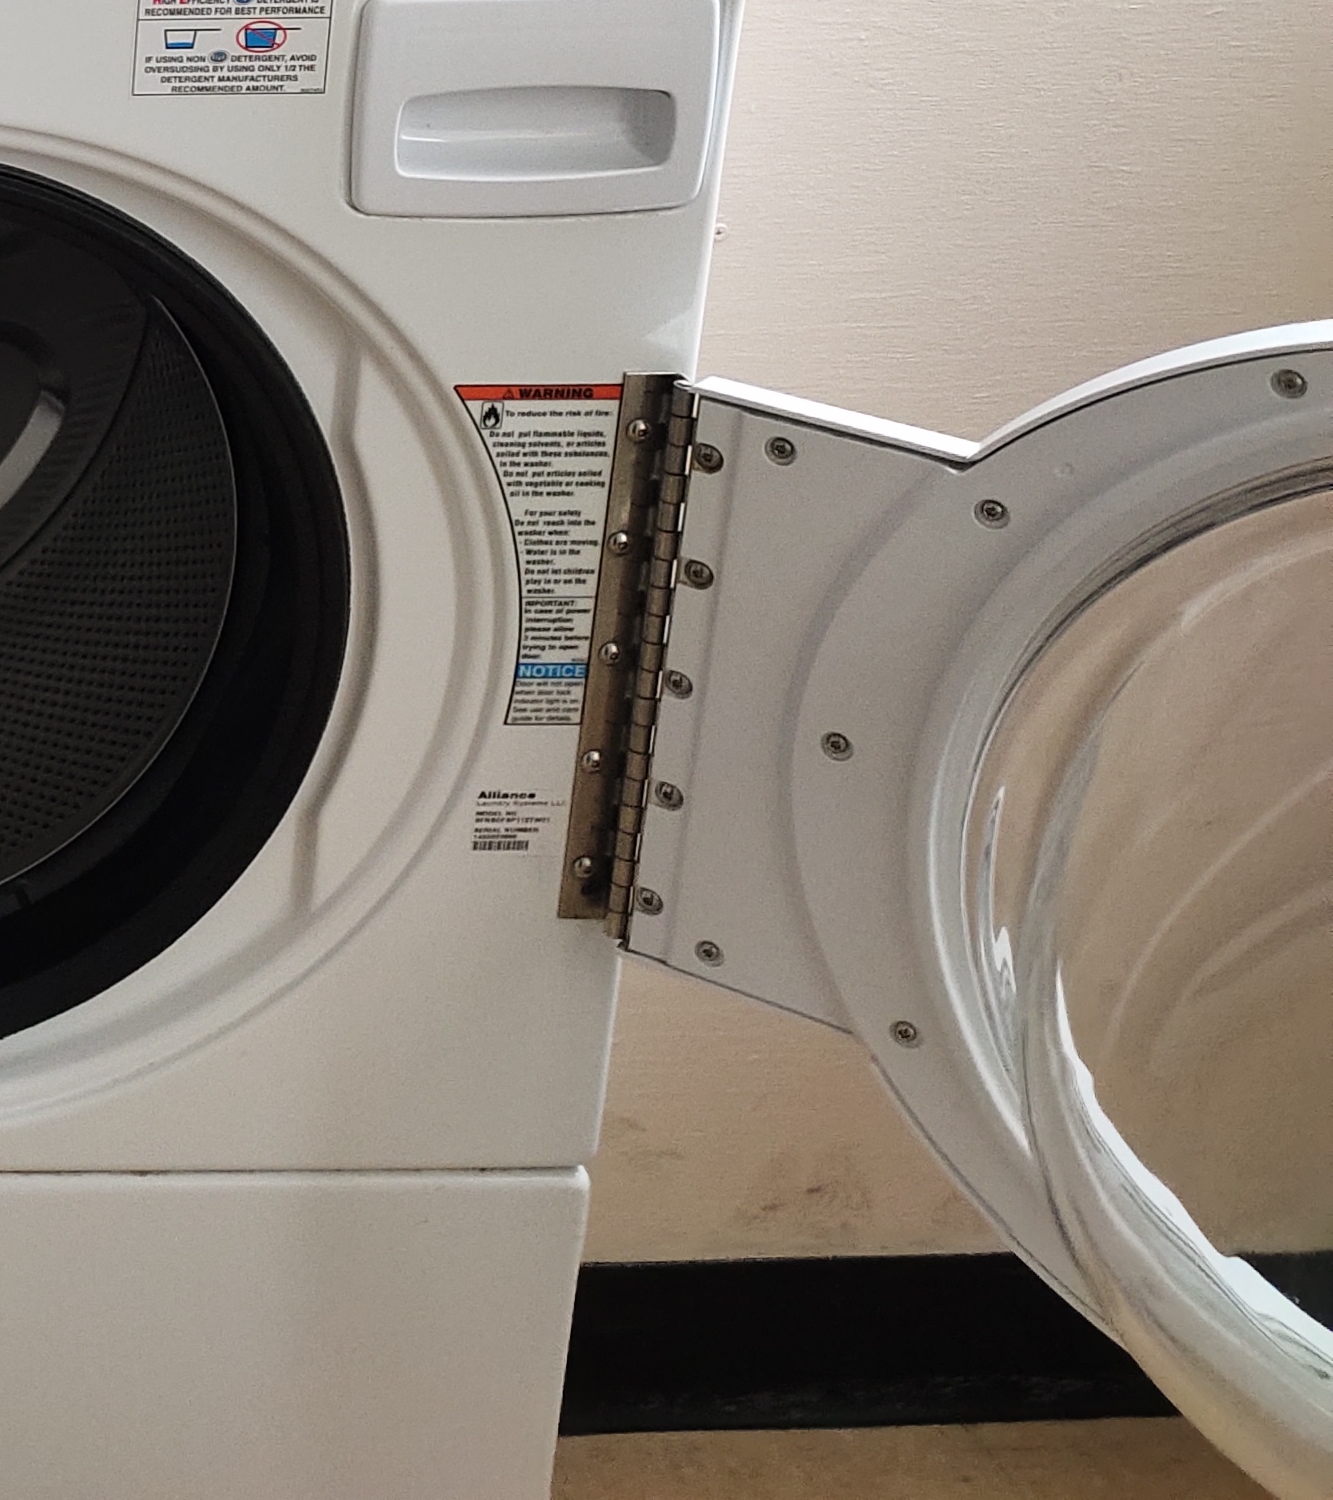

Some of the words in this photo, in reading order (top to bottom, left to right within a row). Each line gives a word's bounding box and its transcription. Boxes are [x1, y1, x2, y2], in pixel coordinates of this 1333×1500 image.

[518, 388, 594, 399] WARNING
[518, 665, 586, 678] NOTICE
[477, 791, 536, 799] Alliance
